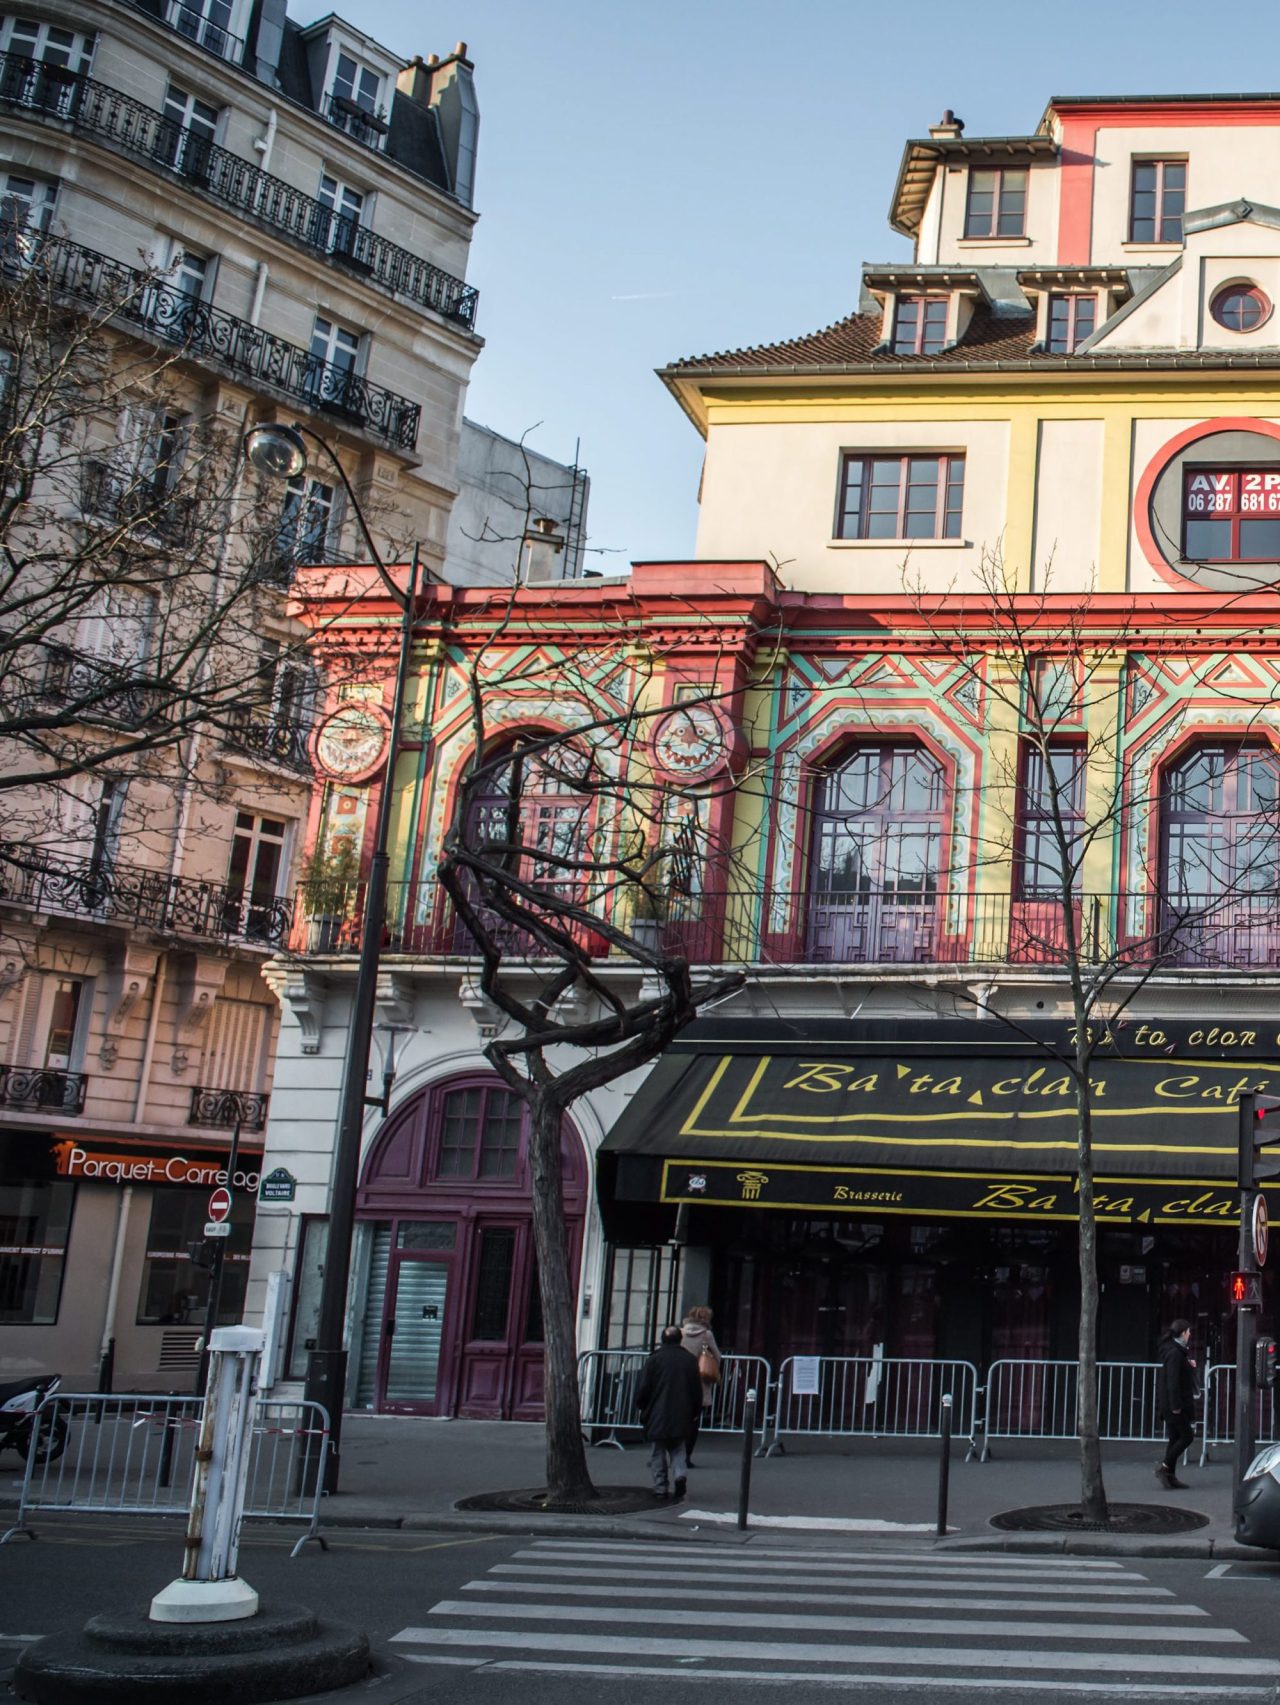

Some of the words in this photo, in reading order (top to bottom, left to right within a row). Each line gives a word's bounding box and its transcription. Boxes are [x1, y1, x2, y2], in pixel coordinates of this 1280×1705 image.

[1190, 475, 1231, 491] AV.
[1188, 493, 1205, 511] 06
[1207, 493, 1232, 511] 287
[1241, 493, 1265, 510] 681
[832, 1186, 903, 1201] Brasserie
[1161, 1192, 1241, 1215] cla
